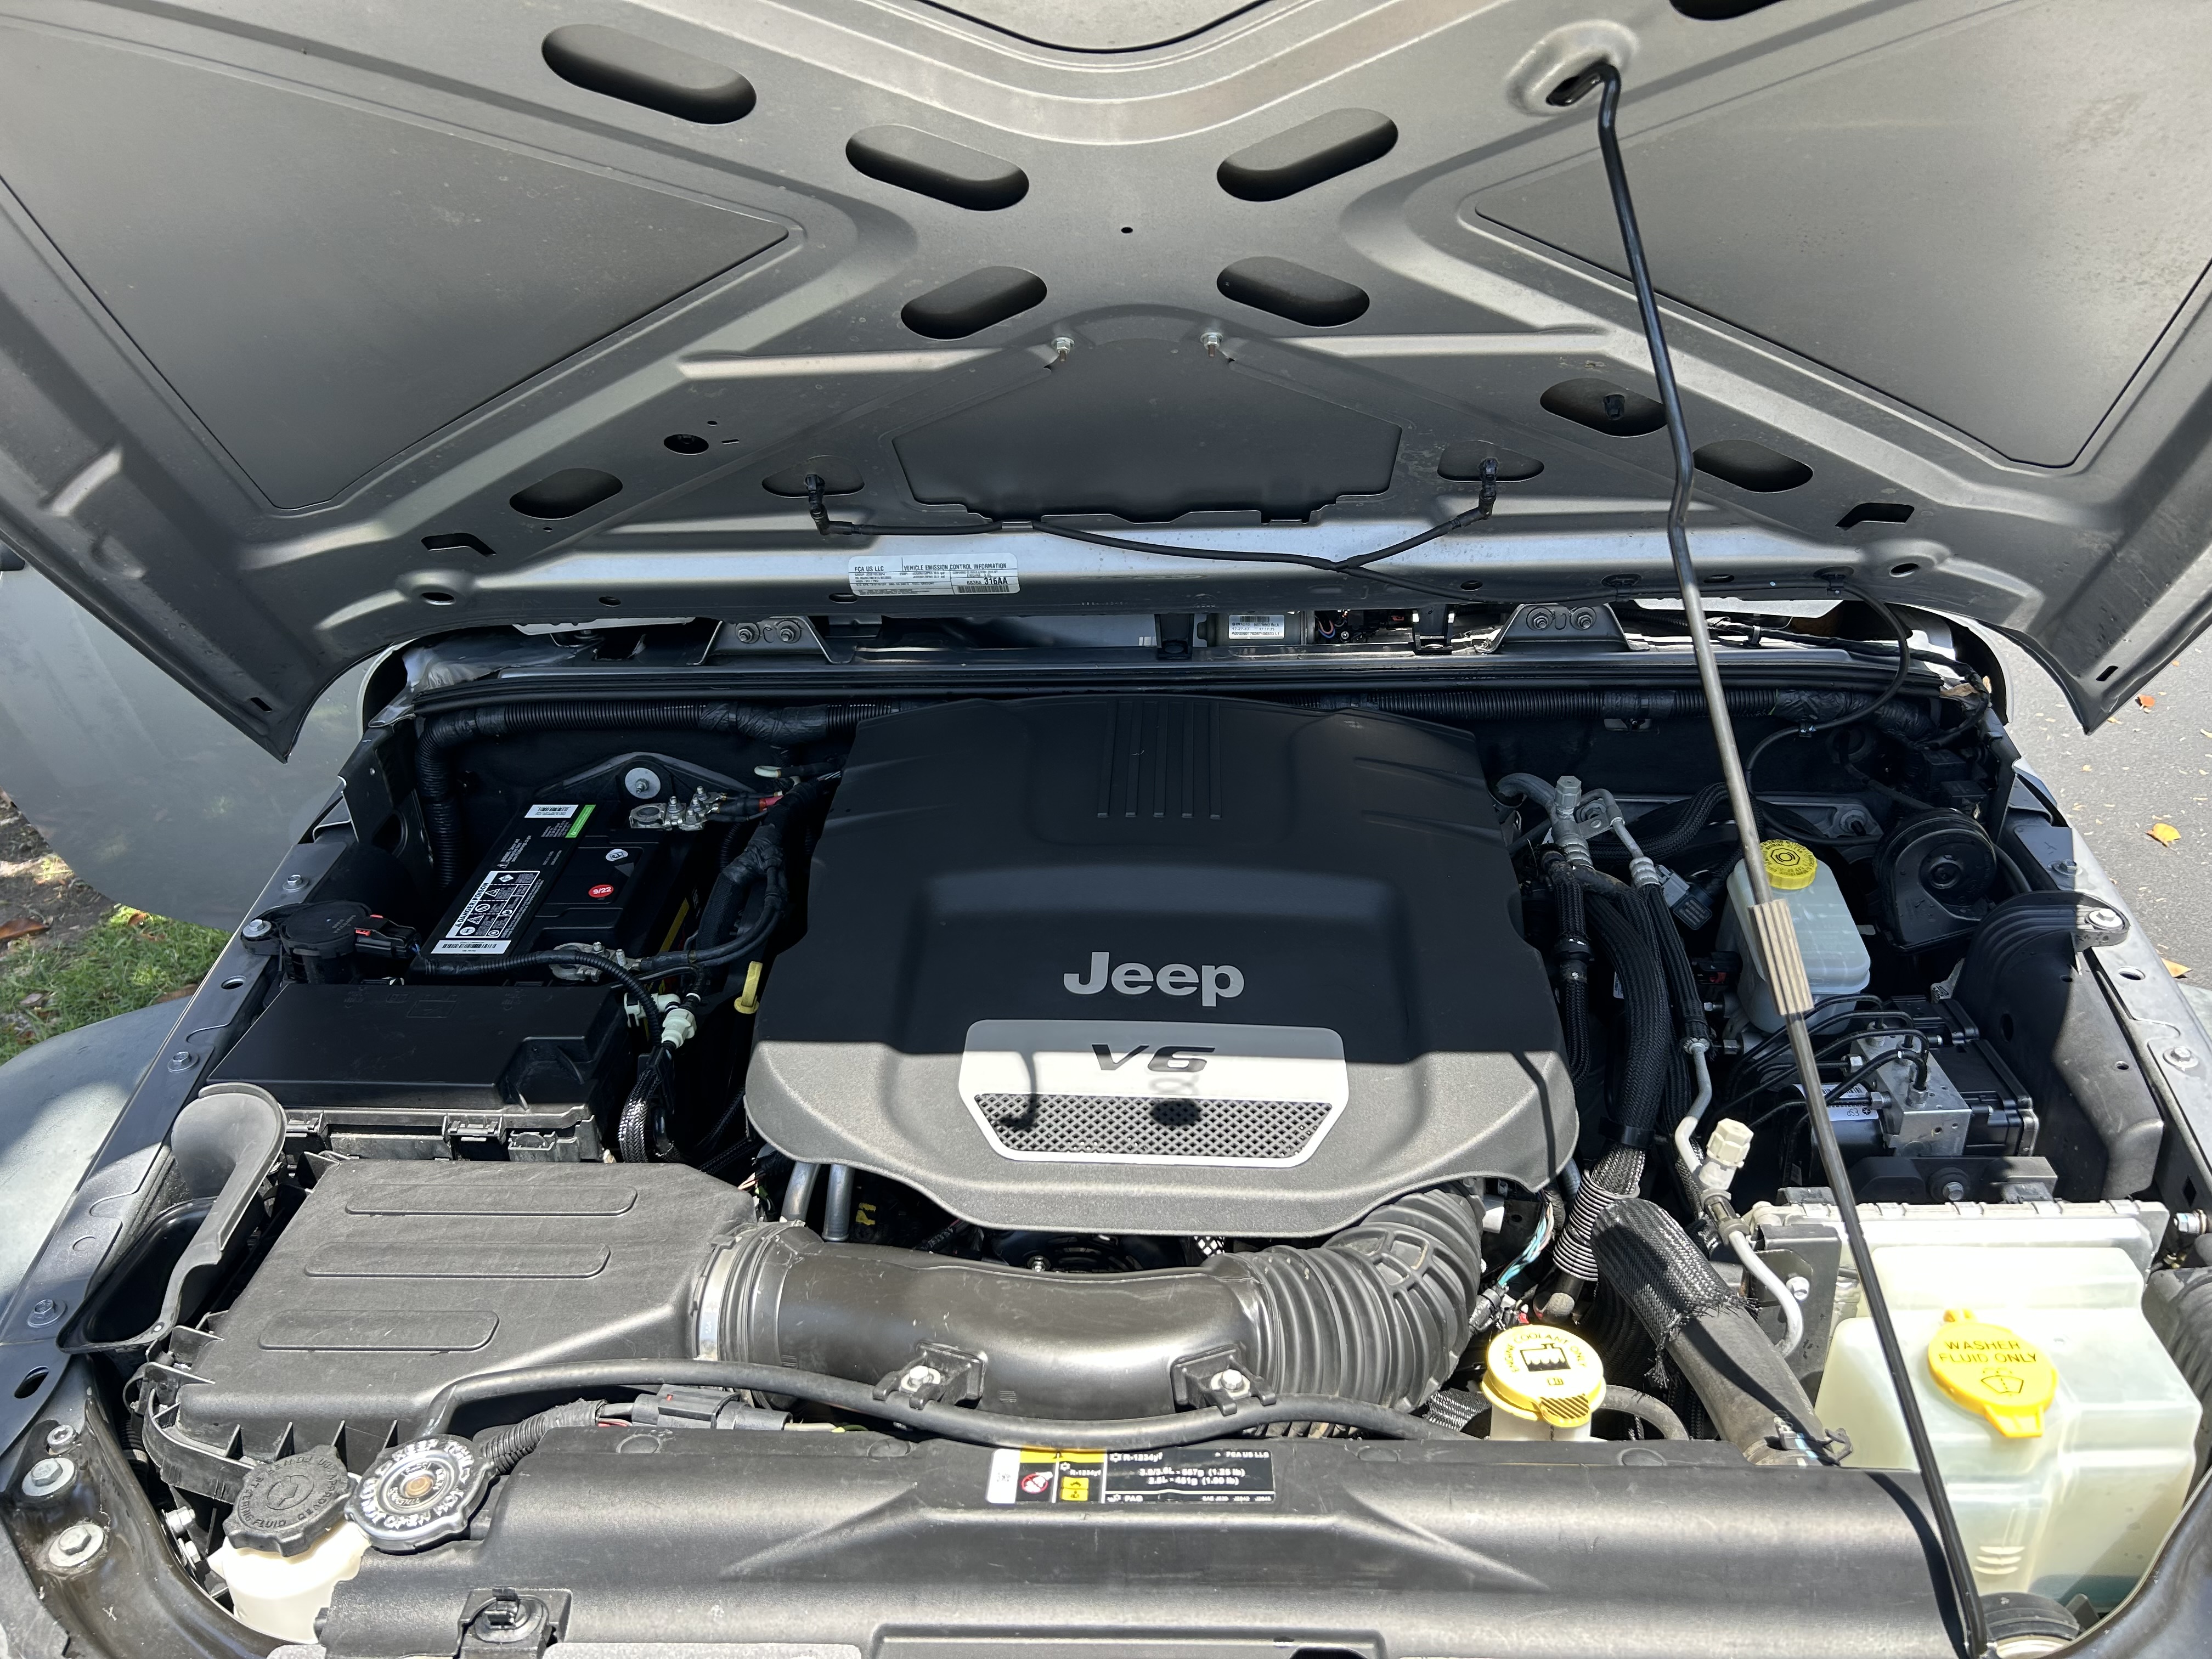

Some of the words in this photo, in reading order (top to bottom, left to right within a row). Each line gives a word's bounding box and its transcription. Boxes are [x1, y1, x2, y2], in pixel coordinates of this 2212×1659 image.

[984, 577, 1008, 585] 316AA
[1063, 951, 1245, 1007] Jeep
[1091, 1043, 1216, 1073] V6
[1846, 1108, 1859, 1116] ESP
[1514, 1333, 1569, 1344] COOLANT
[1570, 1346, 1587, 1367] ONLY
[1945, 1340, 2021, 1350] WASHER
[1939, 1353, 1988, 1363] FLUID
[1995, 1353, 2036, 1363] ONLY
[1123, 1452, 1163, 1463] R-1234yf
